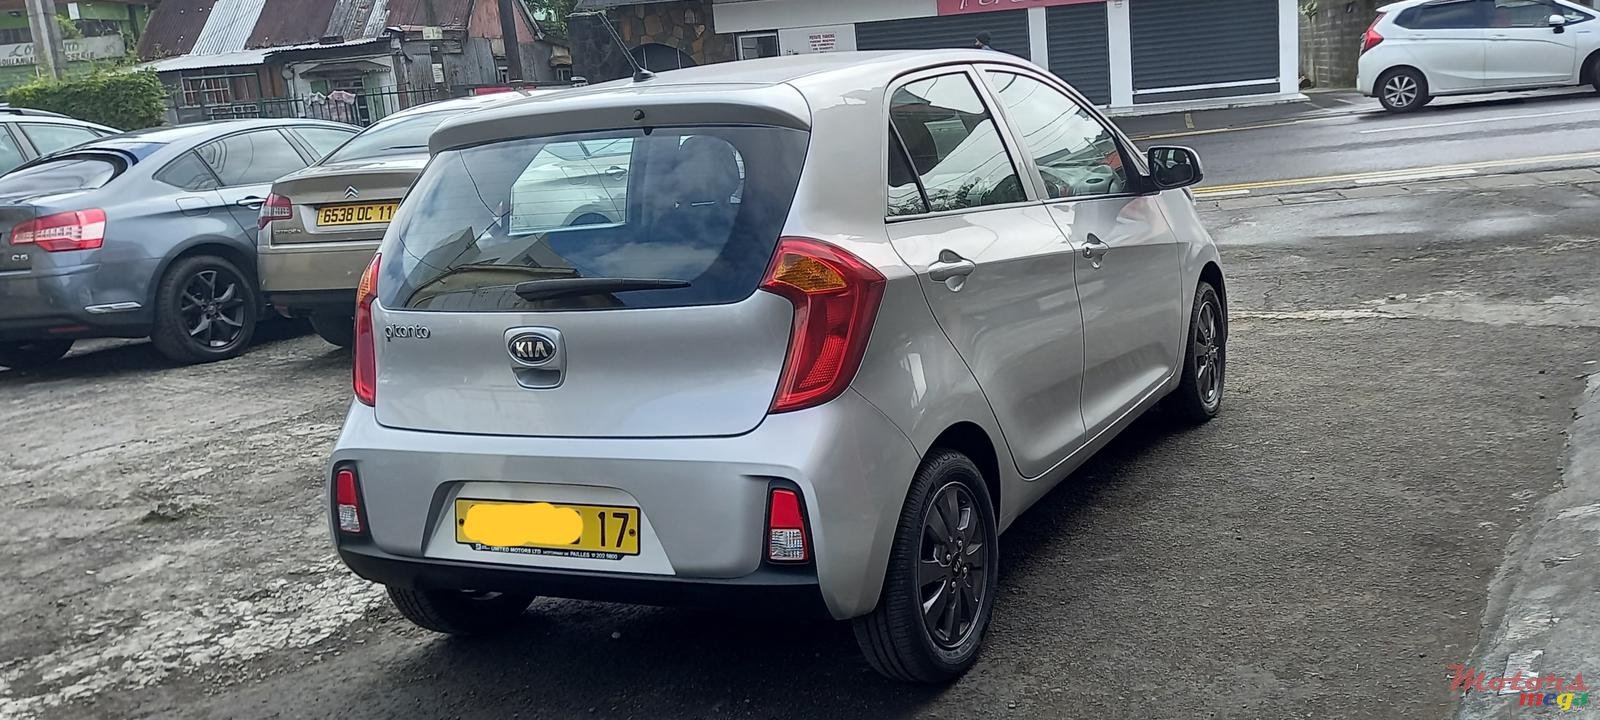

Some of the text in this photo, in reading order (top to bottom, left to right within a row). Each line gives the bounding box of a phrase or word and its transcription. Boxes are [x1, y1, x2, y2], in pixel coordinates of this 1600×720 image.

[323, 207, 354, 223] 6538
[379, 205, 392, 220] 11
[515, 341, 548, 358] KIA
[597, 511, 630, 549] 17
